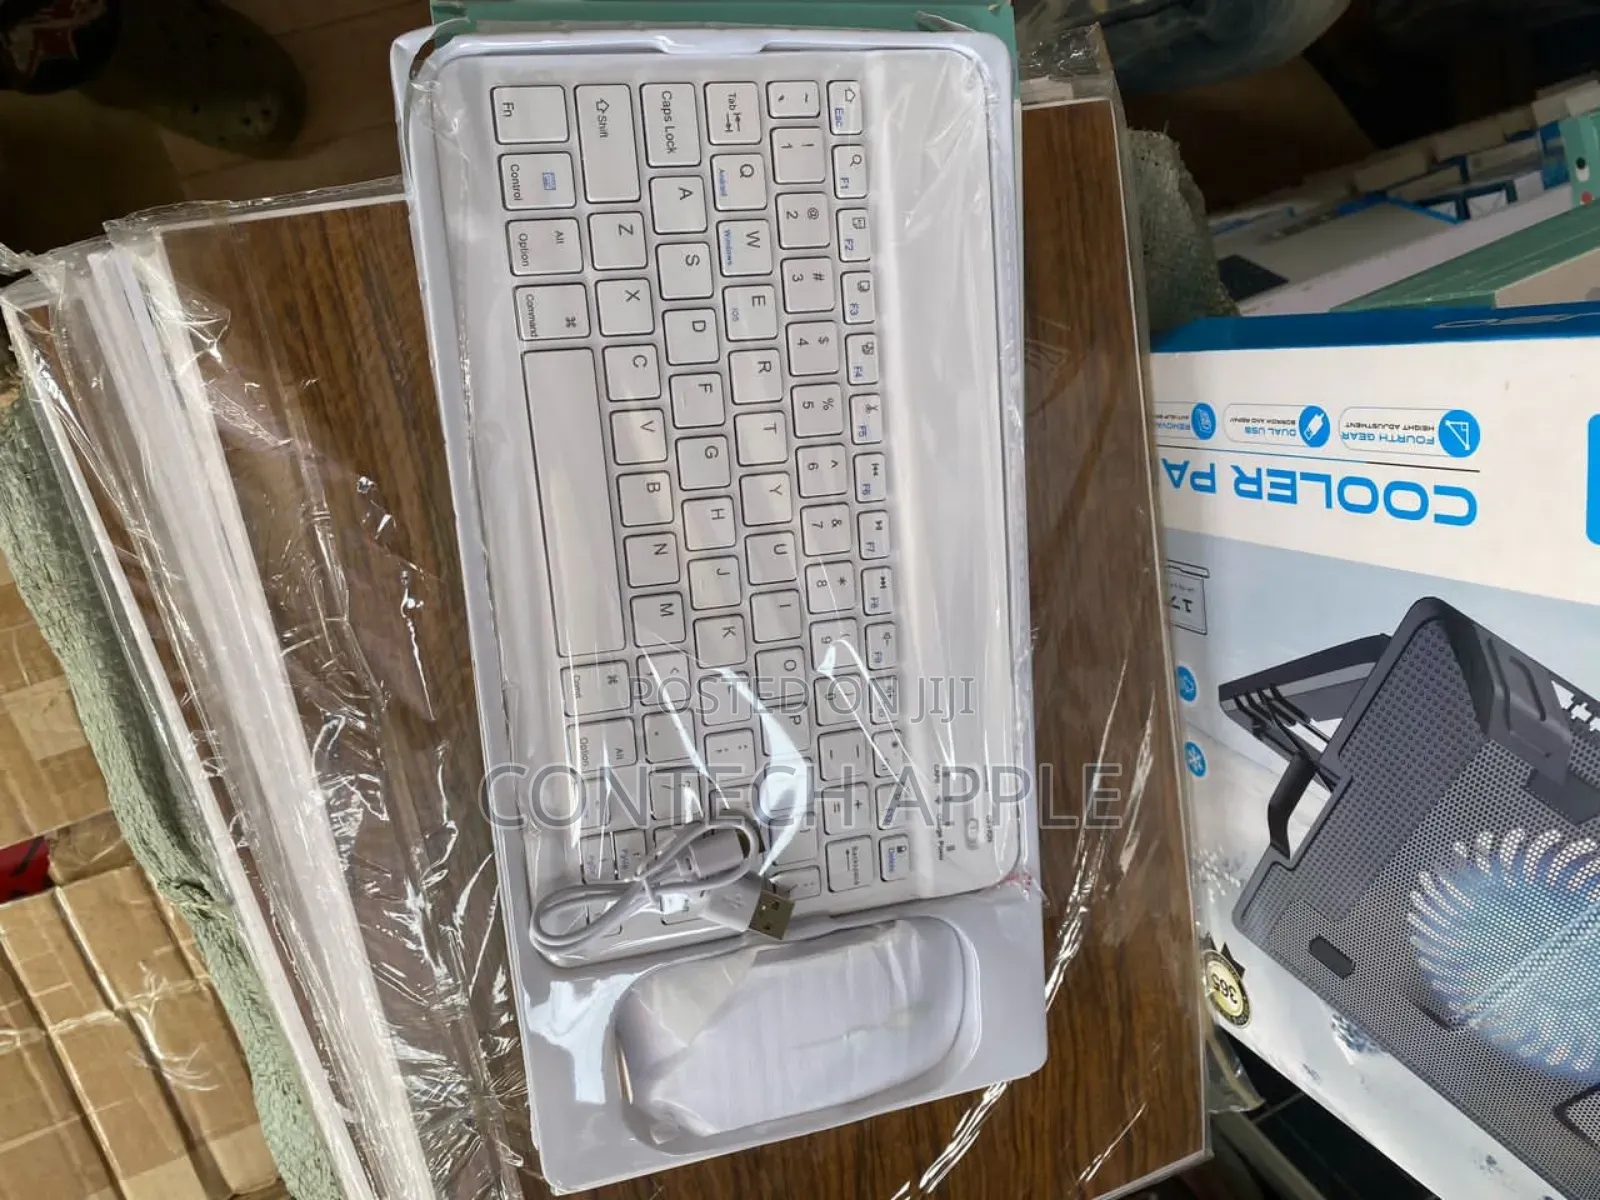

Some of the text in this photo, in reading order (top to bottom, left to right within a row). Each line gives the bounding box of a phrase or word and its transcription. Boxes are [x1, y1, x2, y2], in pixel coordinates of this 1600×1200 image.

[728, 93, 737, 110] Tab
[503, 102, 514, 117] Fn
[598, 115, 608, 137] Shift
[662, 91, 676, 154] Caps Lock
[740, 164, 754, 178] Q
[511, 164, 522, 201] Control
[840, 177, 850, 189] F1
[679, 187, 693, 201] A
[787, 211, 798, 219] 2
[807, 207, 819, 220] @
[618, 224, 634, 235] Z
[555, 231, 564, 244] Alt
[746, 231, 760, 248] W
[519, 233, 528, 266] Option
[724, 229, 733, 265] Windows
[845, 238, 853, 250] F2
[685, 254, 700, 266] S
[792, 274, 803, 282] 3
[813, 273, 824, 281] #
[625, 290, 641, 301] X
[752, 295, 765, 307] E
[850, 303, 859, 315] F3
[527, 294, 538, 337] Command
[692, 320, 706, 332] D
[797, 338, 809, 346] 4
[633, 355, 647, 368] C
[758, 361, 772, 373] R
[854, 366, 862, 377] F4
[699, 383, 712, 392] F
[803, 401, 814, 409] 5
[822, 398, 834, 410] %
[640, 420, 654, 433] V
[763, 423, 776, 433] T
[859, 425, 866, 437] F5
[1244, 426, 1296, 437] DUAL USB
[1344, 422, 1435, 432] HEIGHT ADJUSTMENT
[1341, 431, 1435, 445] FOURTH GEAR
[705, 446, 719, 459] G
[647, 482, 660, 493] B
[770, 485, 782, 495] Y
[862, 484, 871, 495] F6
[1231, 464, 1477, 526] COOLER
[711, 508, 725, 520] H
[812, 521, 823, 529] 7
[831, 519, 842, 527] &
[653, 543, 668, 555] N
[774, 544, 787, 554] U
[866, 542, 875, 552] F7
[817, 579, 827, 587] 8
[660, 603, 674, 617] M
[722, 626, 737, 638] K
[821, 636, 832, 644] 9
[784, 659, 797, 671] O
[790, 715, 800, 725] P
[1211, 973, 1239, 1005] 365
